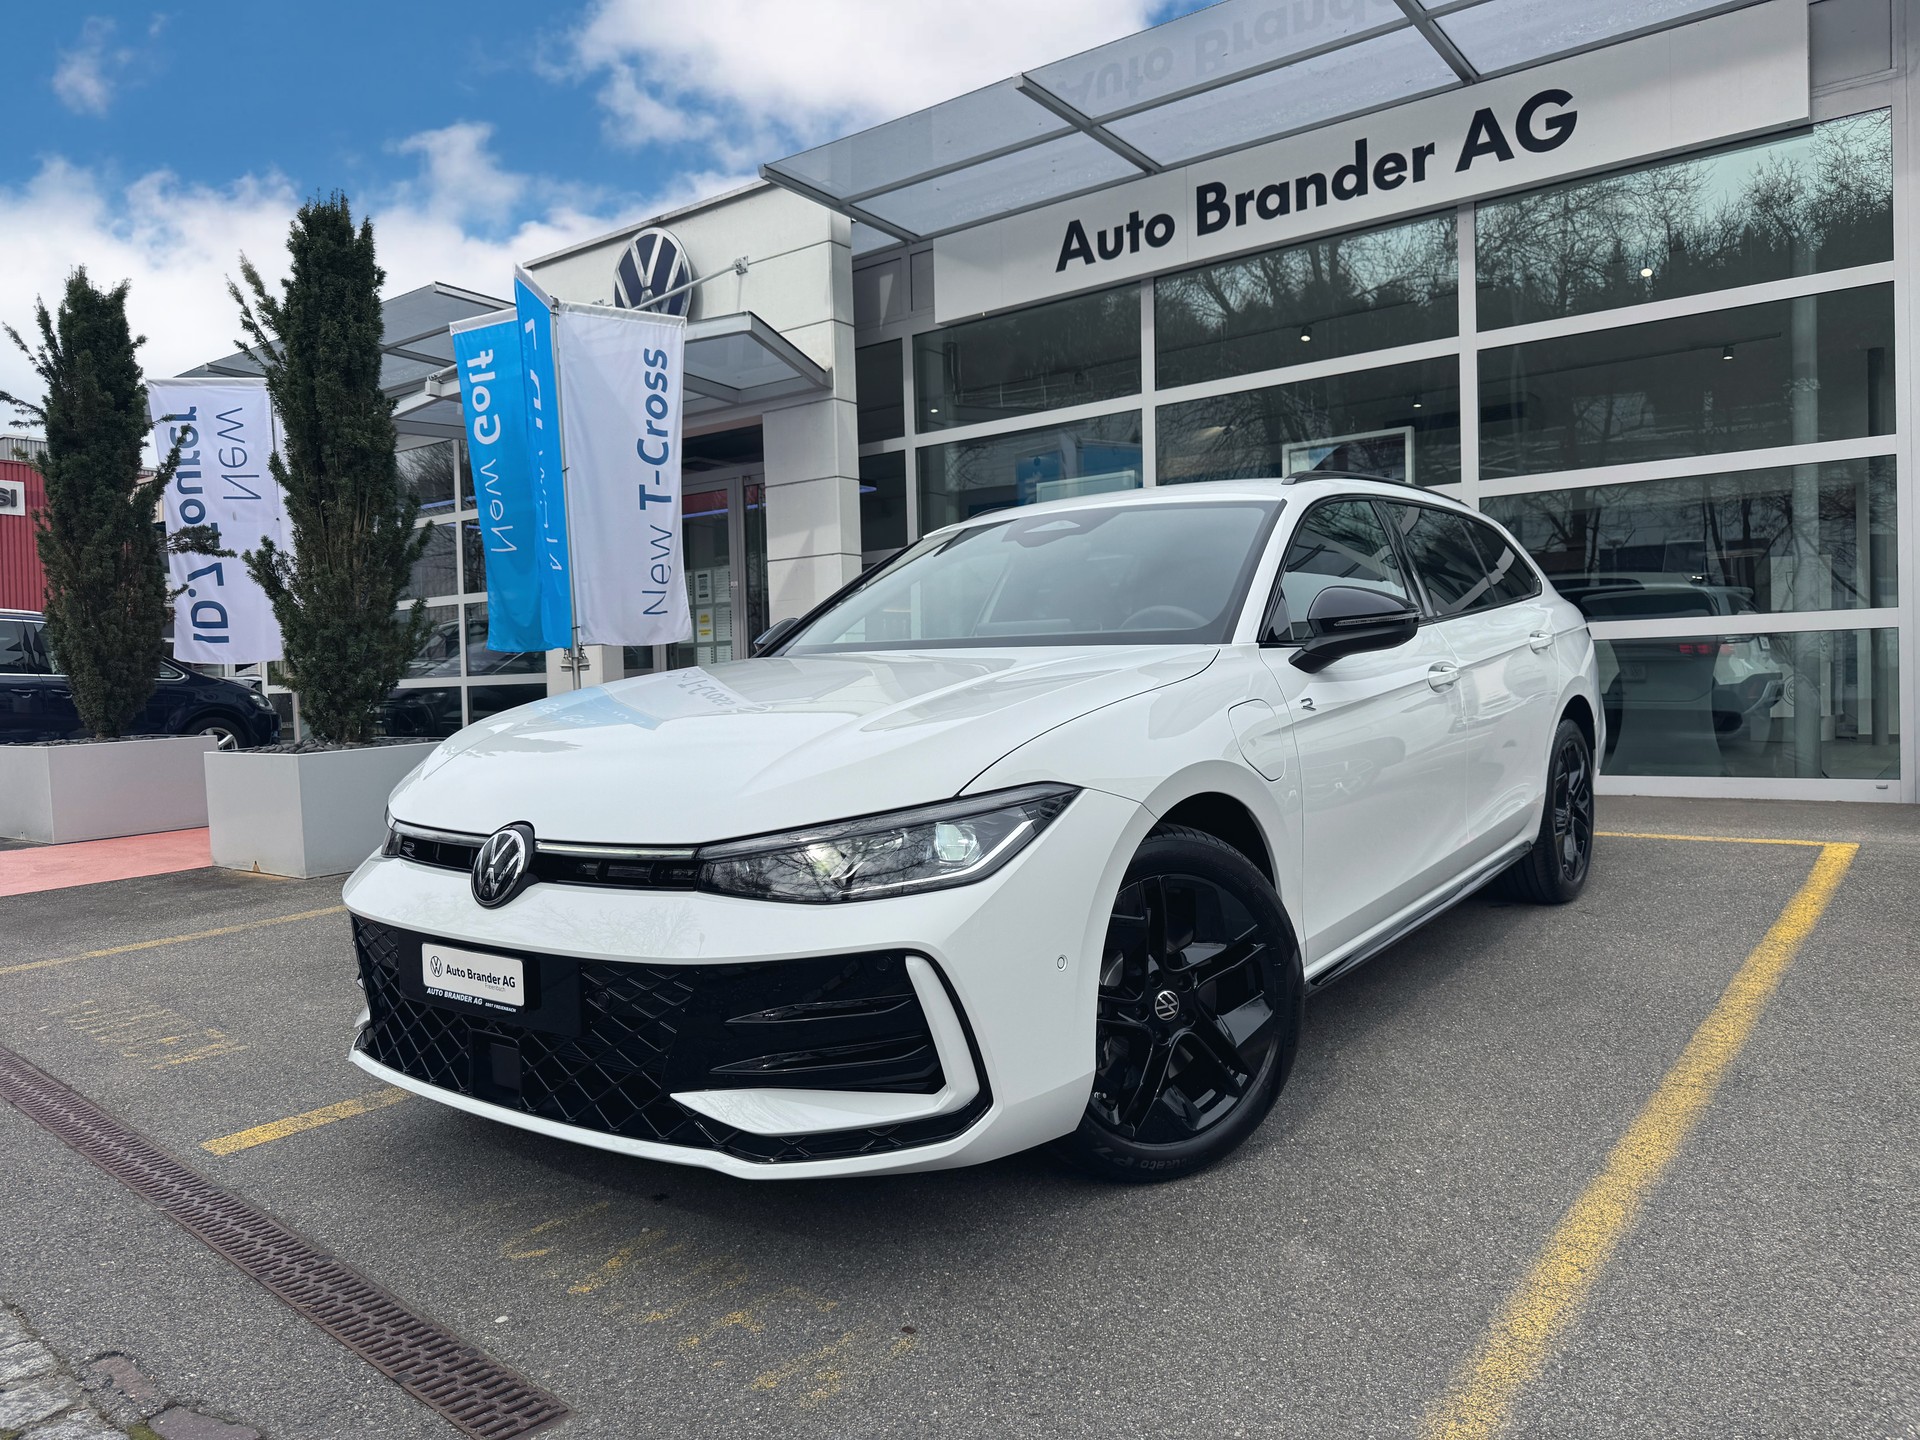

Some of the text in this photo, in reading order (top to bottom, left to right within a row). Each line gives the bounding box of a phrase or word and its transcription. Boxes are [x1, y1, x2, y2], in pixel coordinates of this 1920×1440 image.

[1056, 89, 1578, 273] Auto Brander AG
[637, 348, 673, 616] New T-Cross
[426, 987, 483, 1006] AUTO BRANDER AG
[446, 964, 516, 988] Auto Brander AG
